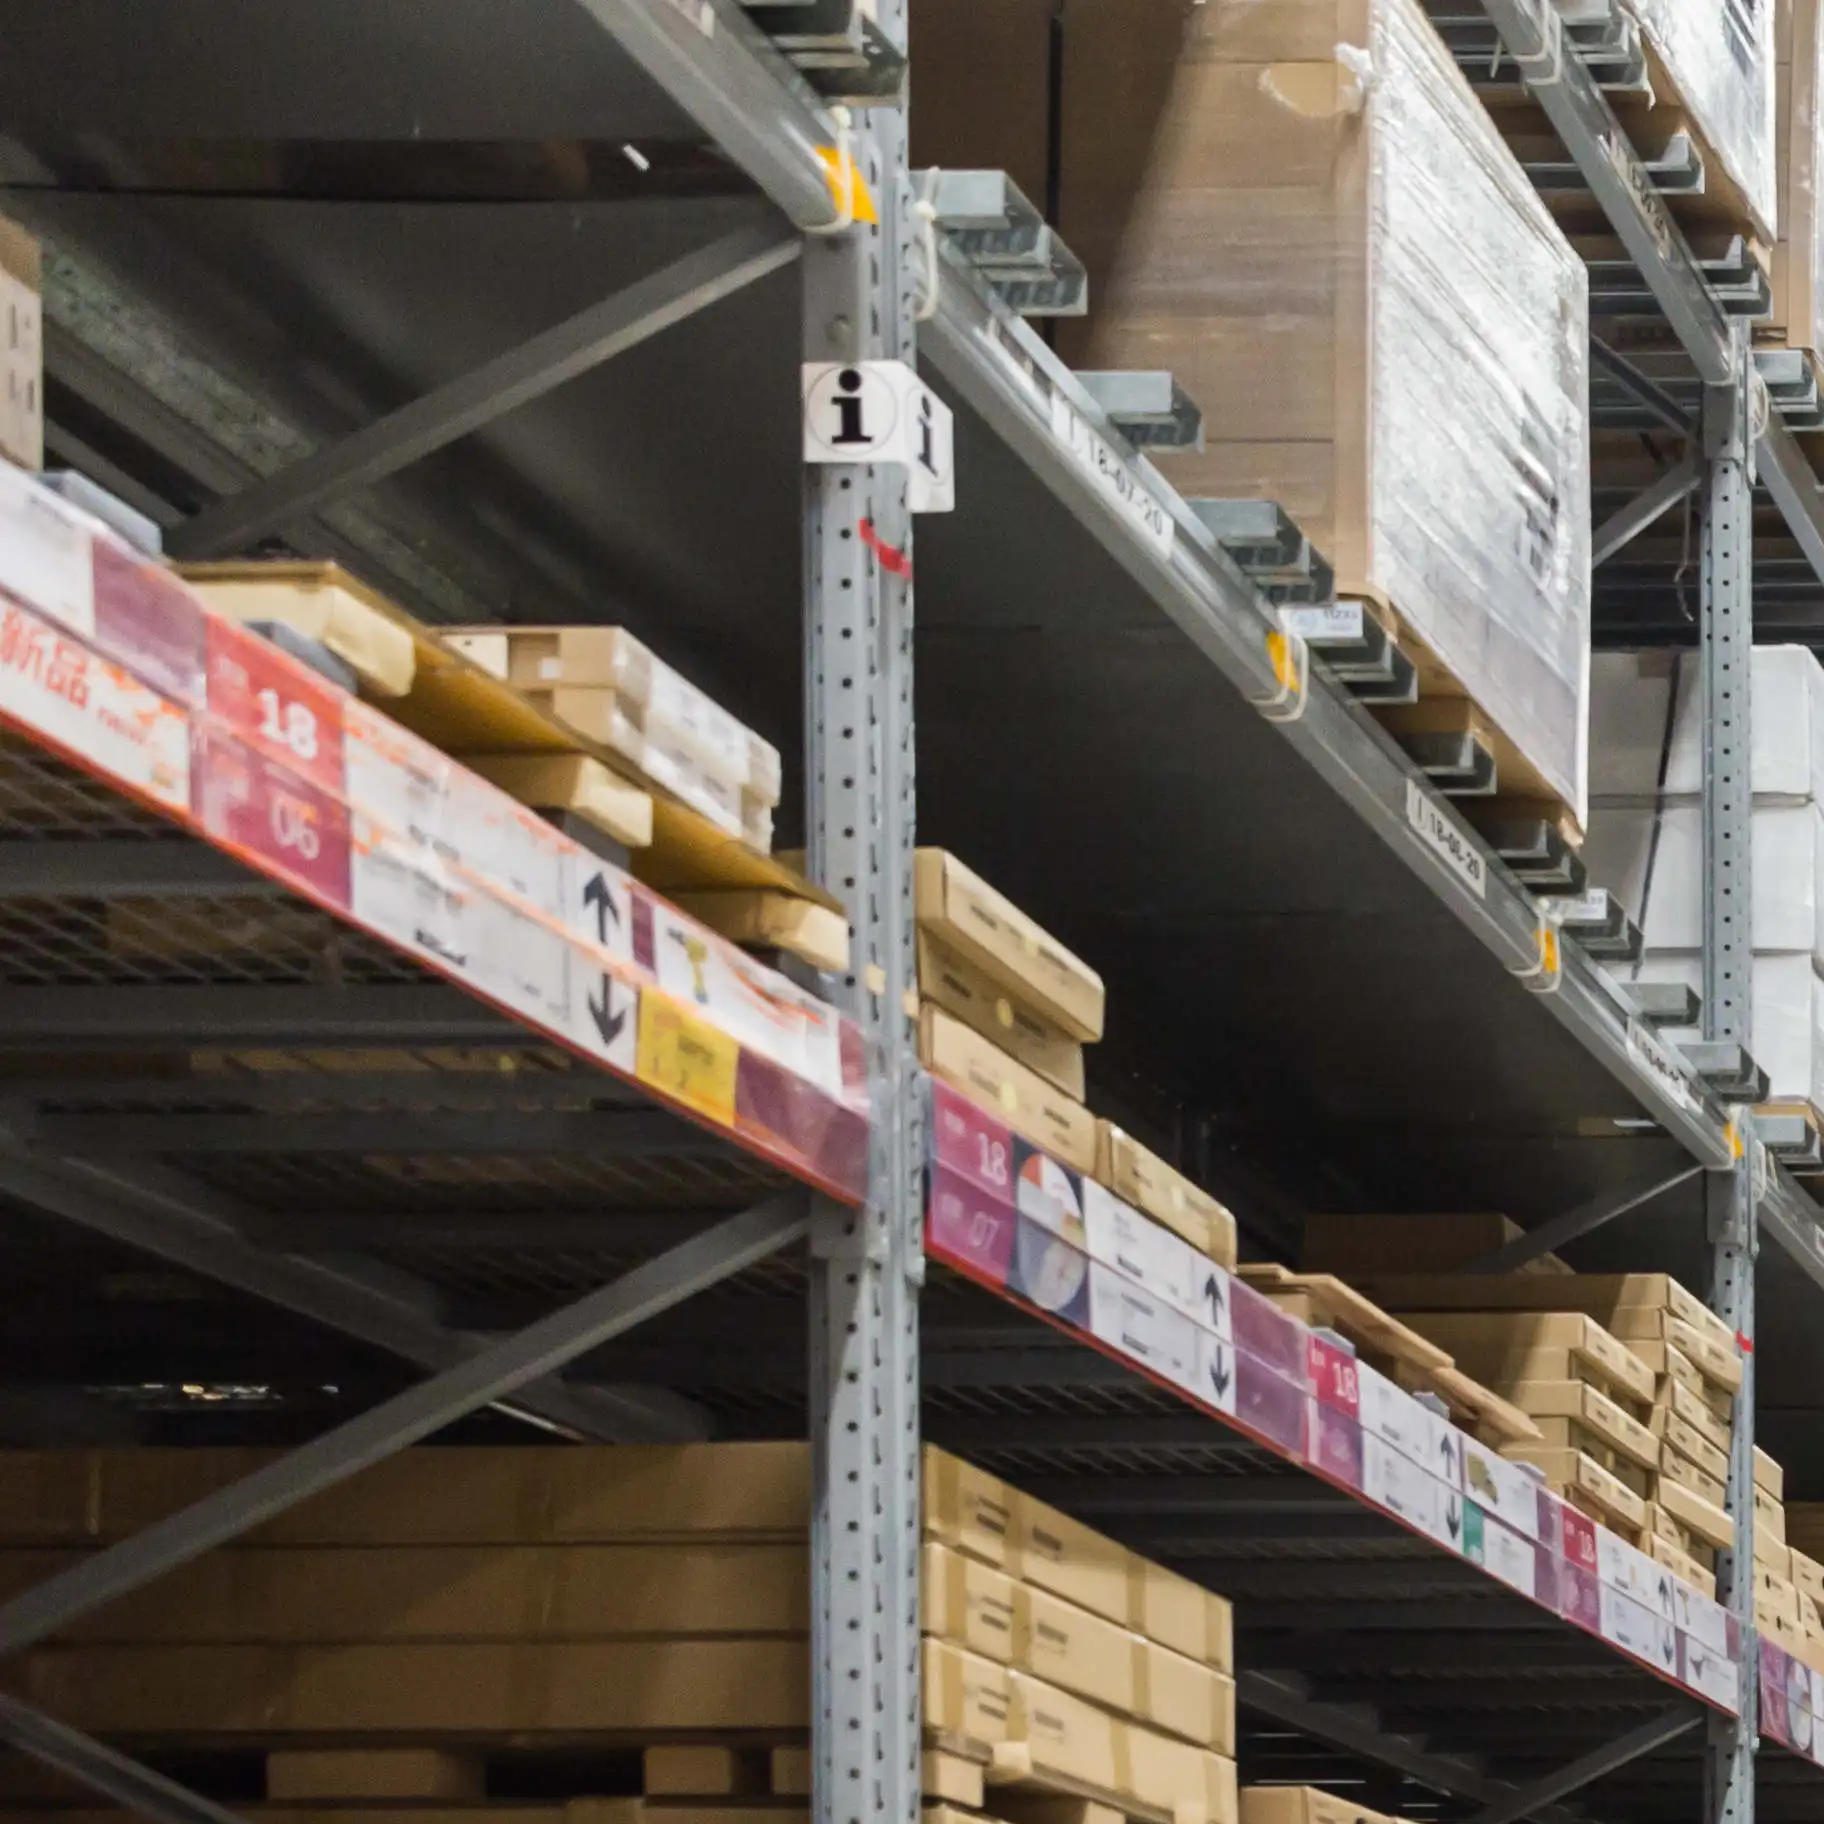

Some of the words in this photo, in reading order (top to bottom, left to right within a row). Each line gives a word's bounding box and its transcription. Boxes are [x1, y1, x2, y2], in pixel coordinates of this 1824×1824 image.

[832, 369, 872, 444] i
[256, 687, 318, 759] 18
[977, 1132, 1008, 1186] 18
[1332, 1361, 1358, 1404] 18
